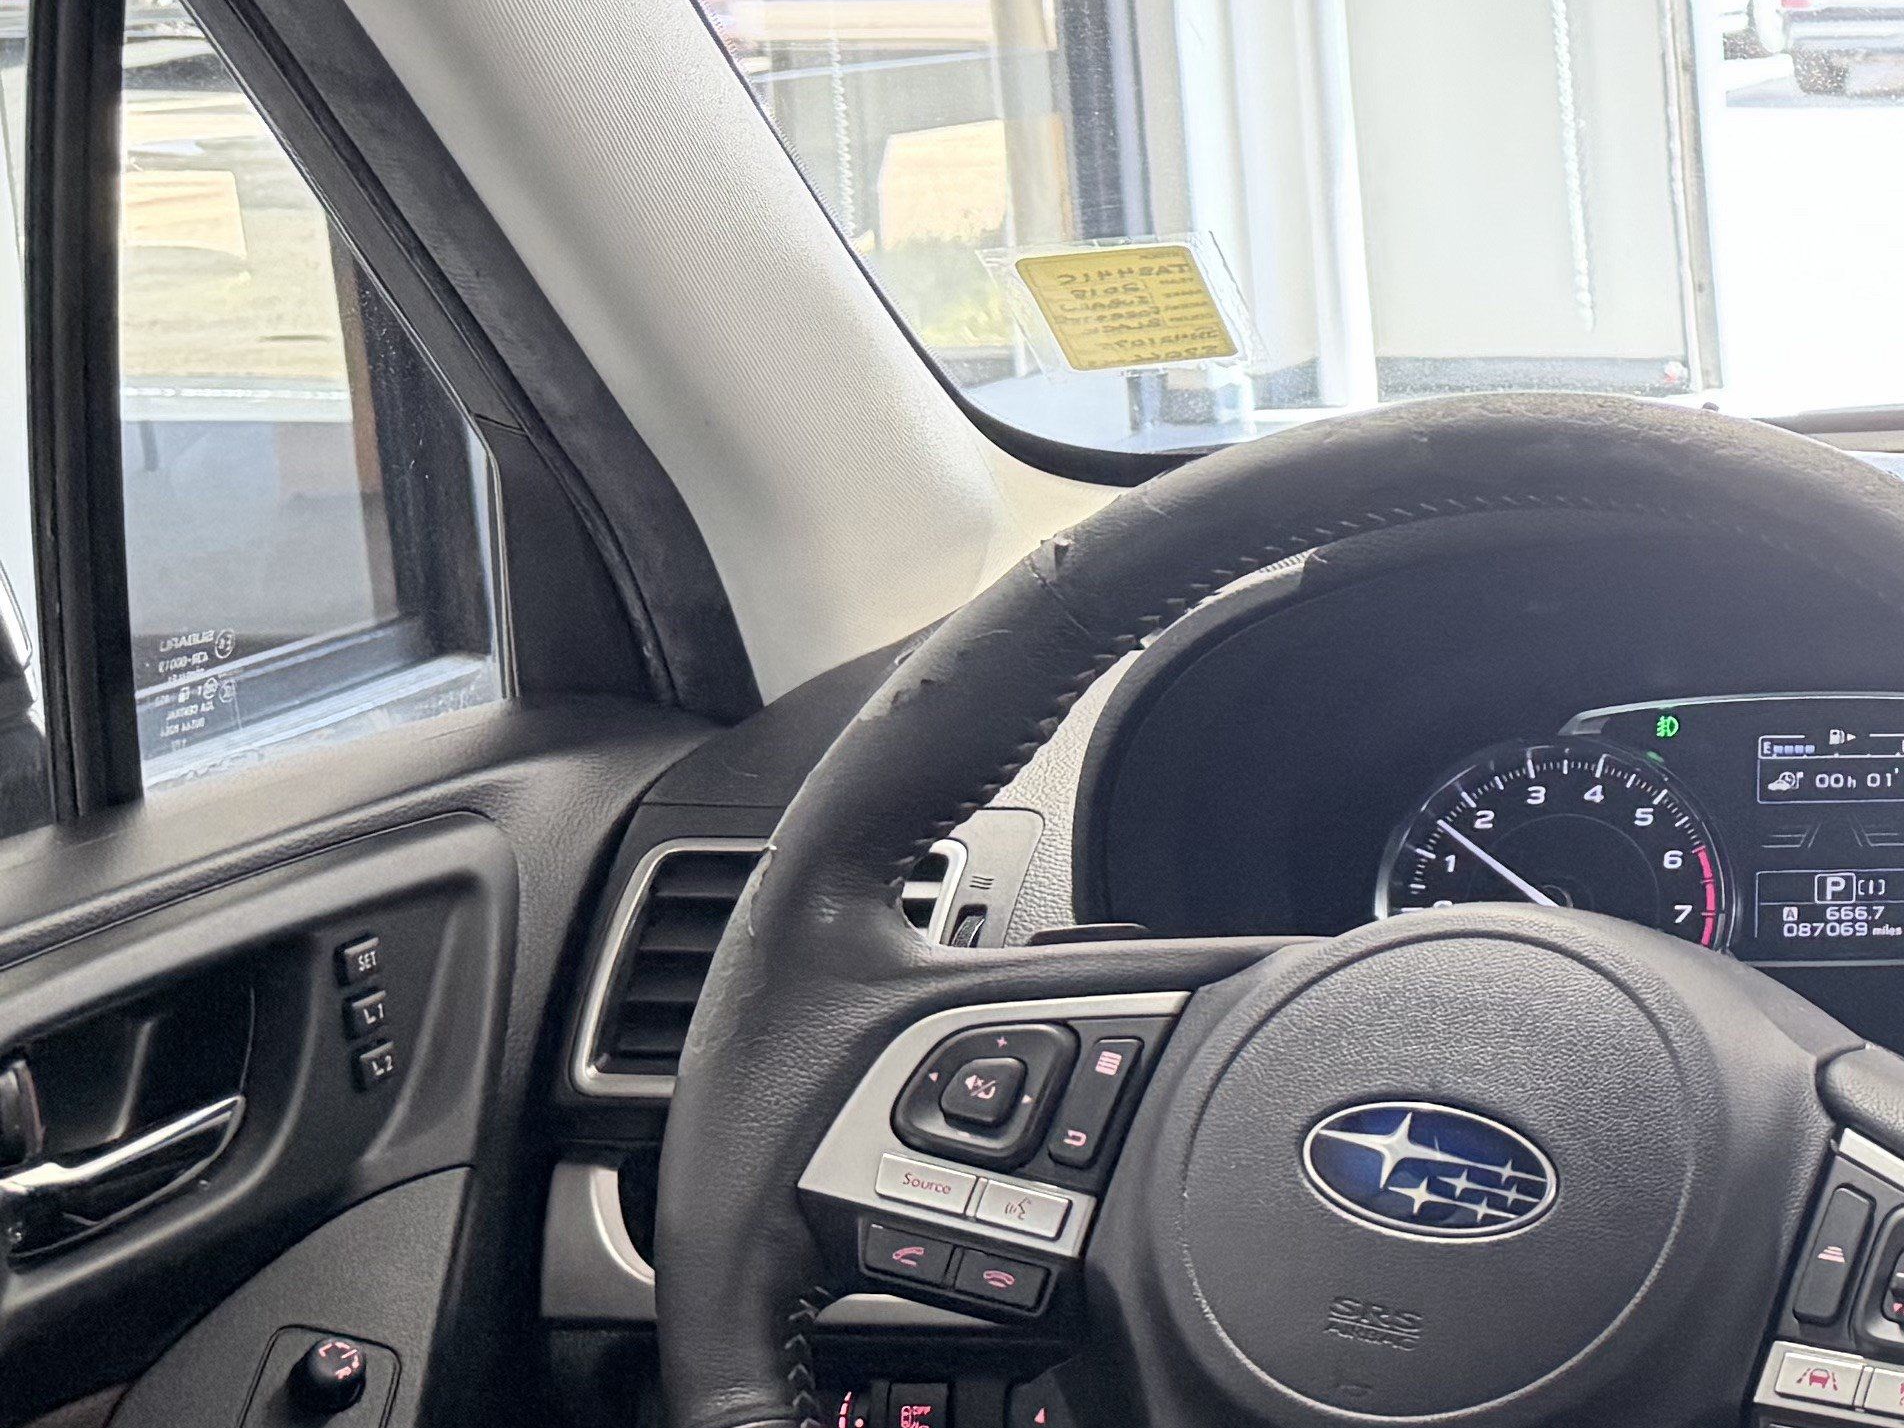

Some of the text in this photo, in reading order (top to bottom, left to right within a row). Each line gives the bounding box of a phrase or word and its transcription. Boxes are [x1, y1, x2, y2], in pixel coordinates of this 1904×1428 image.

[1763, 741, 1772, 754] E
[1527, 786, 1546, 804] 3
[1584, 785, 1604, 803] 4
[1474, 810, 1495, 829] 2
[1634, 808, 1654, 826] 5
[1445, 855, 1456, 873] 1
[1663, 850, 1683, 869] 6
[1826, 876, 1846, 901] P
[1674, 905, 1692, 923] 7
[1826, 906, 1885, 920] 666.7
[1783, 922, 1903, 938] 087069 miles
[358, 951, 377, 972] SET
[902, 1173, 952, 1195] Source
